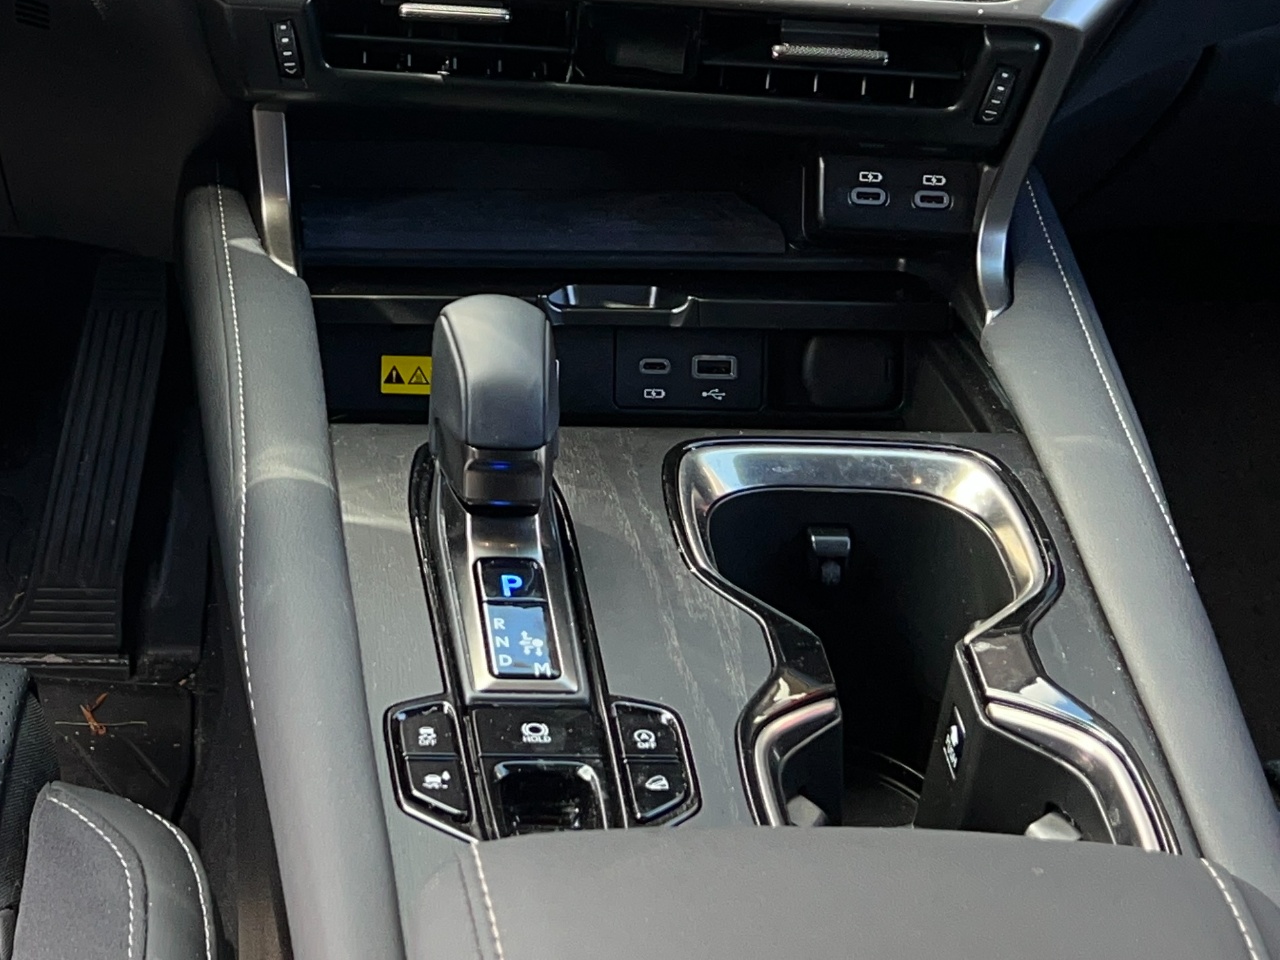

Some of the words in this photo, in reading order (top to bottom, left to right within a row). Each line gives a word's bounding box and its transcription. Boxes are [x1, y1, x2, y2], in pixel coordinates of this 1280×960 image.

[501, 574, 522, 597] P
[493, 617, 505, 630] R
[495, 636, 509, 648] N
[499, 654, 512, 666] D
[534, 662, 551, 677] M
[637, 741, 657, 749] OFF
